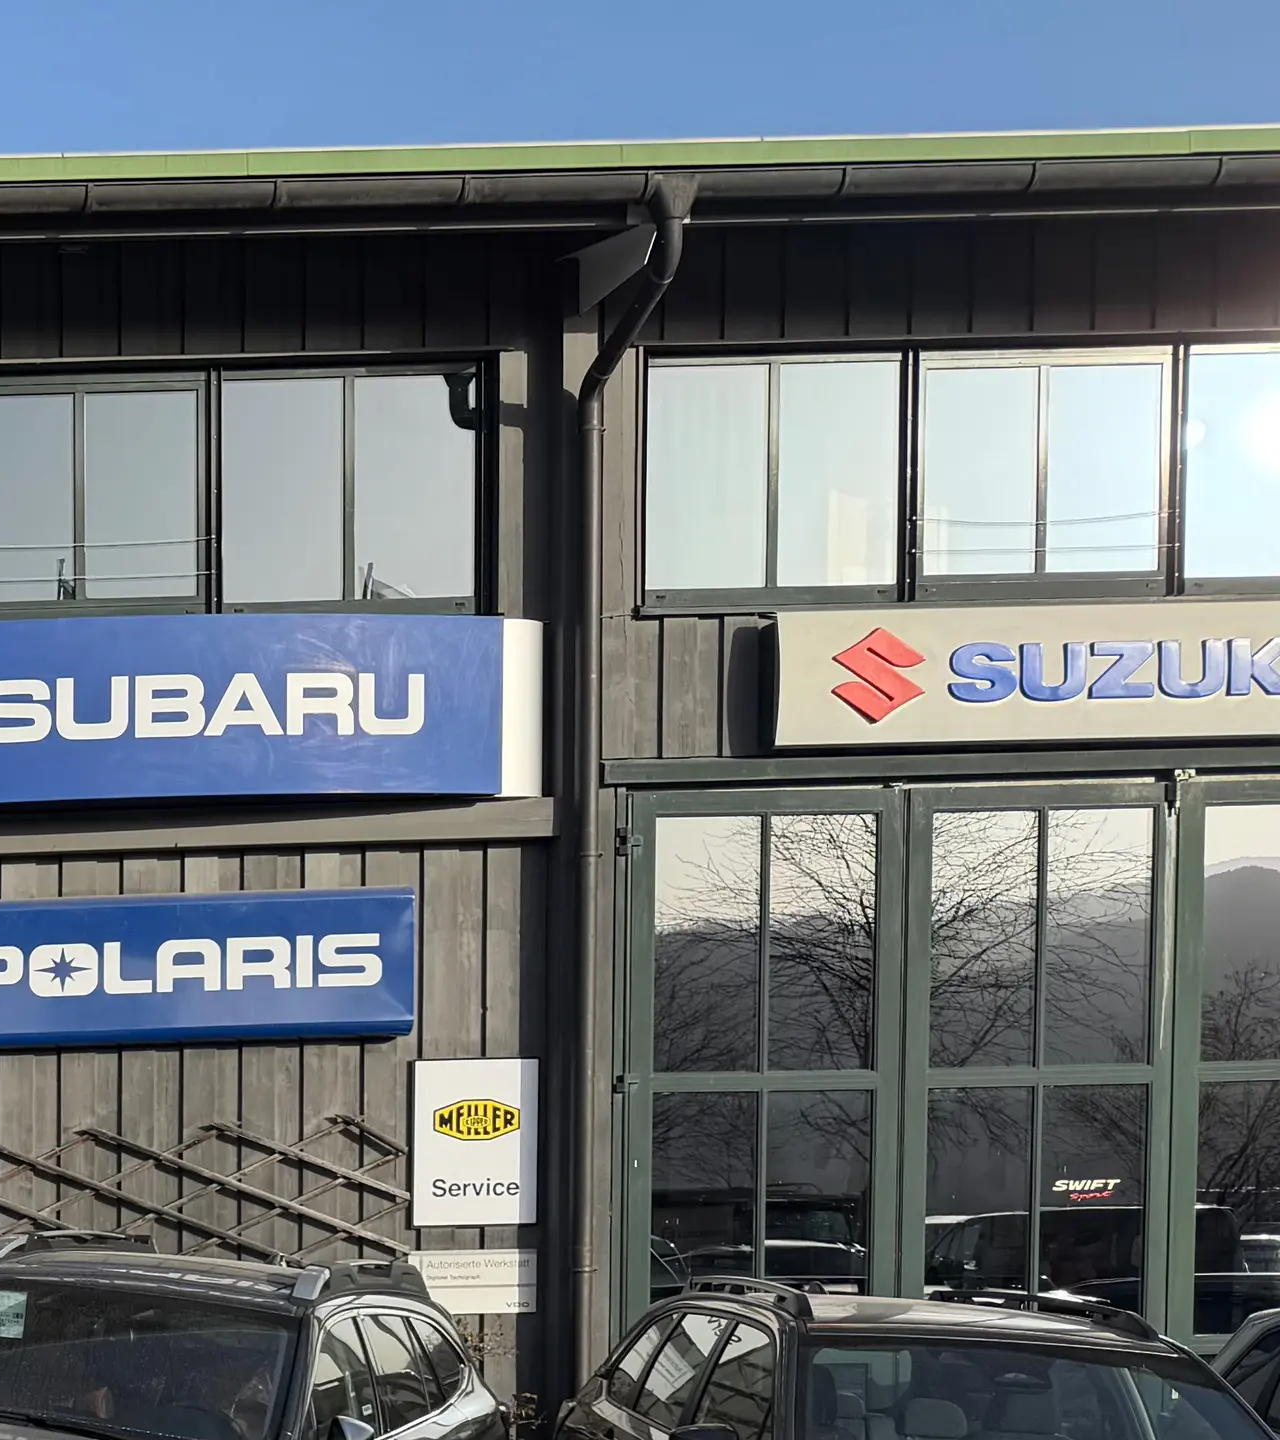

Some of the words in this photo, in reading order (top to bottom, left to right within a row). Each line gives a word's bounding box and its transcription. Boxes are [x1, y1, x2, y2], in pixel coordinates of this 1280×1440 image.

[438, 1103, 516, 1136] MEILLER
[432, 1177, 520, 1198] Service
[1052, 1178, 1121, 1192] SWIFT
[426, 1259, 481, 1270] Autorisierte
[483, 1258, 530, 1269] Werkstatt
